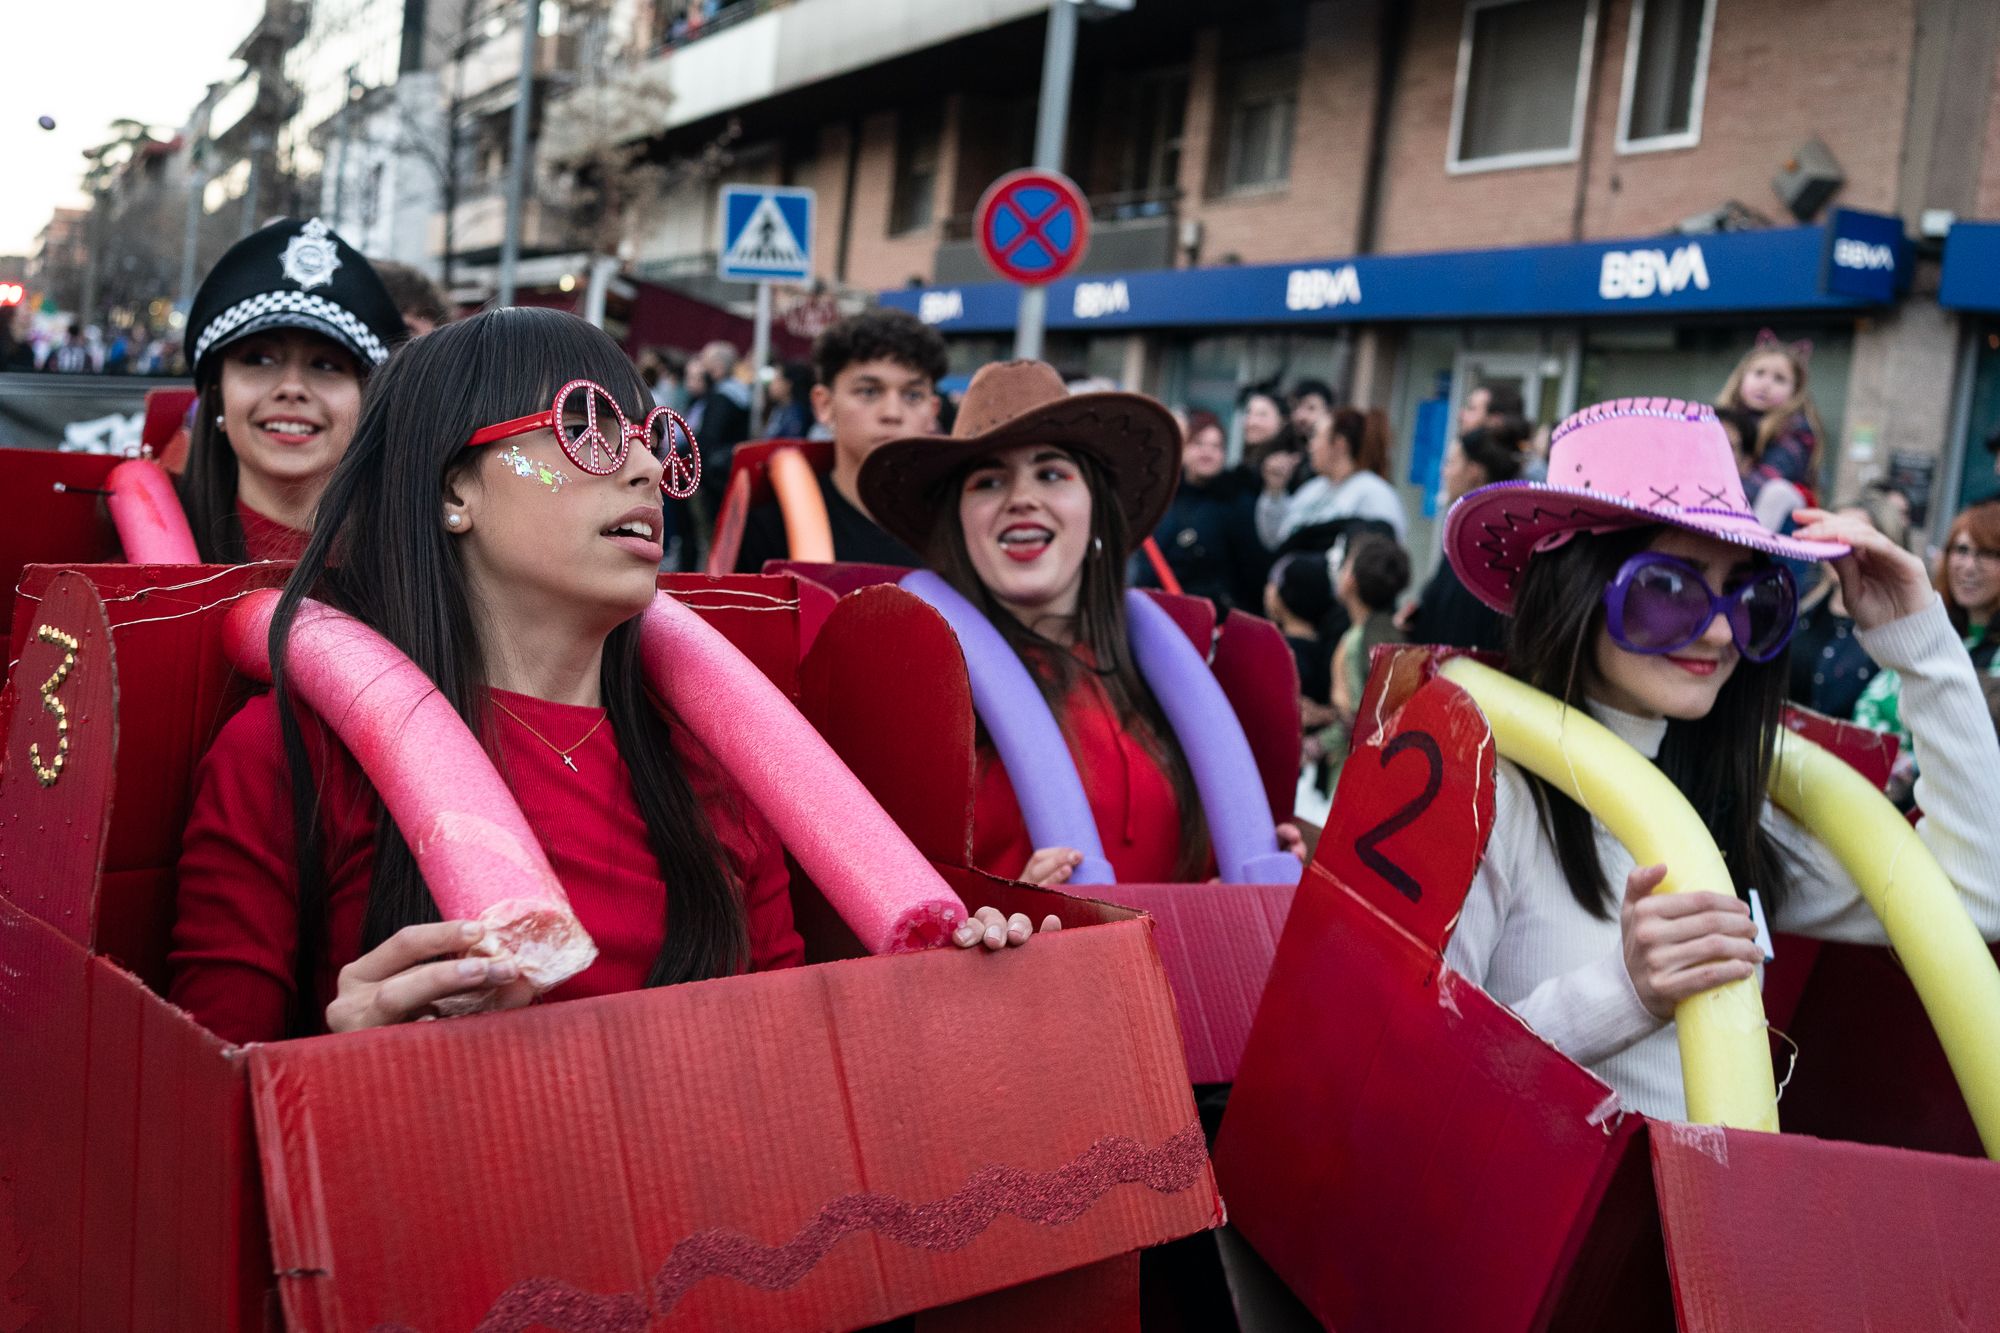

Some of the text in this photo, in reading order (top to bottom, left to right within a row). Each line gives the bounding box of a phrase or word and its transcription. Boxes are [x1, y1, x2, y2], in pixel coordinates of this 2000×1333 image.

[1600, 243, 1709, 299] BBVA
[1834, 238, 1894, 271] BBVA
[1286, 265, 1361, 310] BBVA
[30, 624, 78, 787] 3
[1355, 730, 1443, 904] 2
